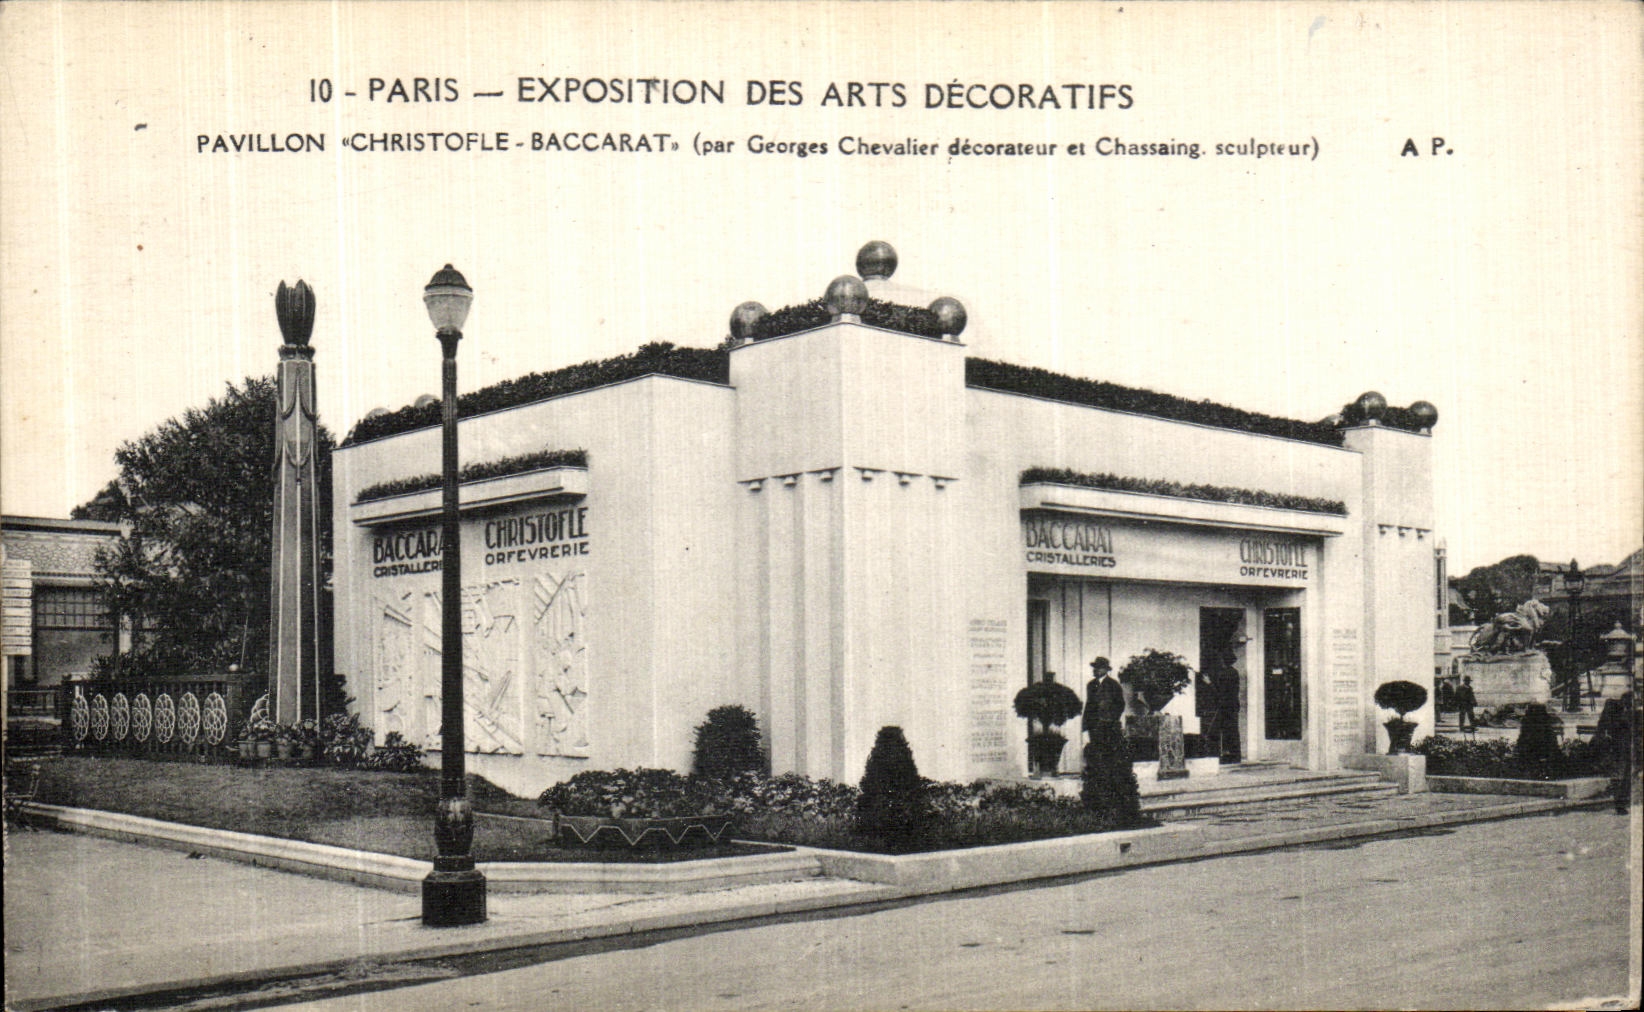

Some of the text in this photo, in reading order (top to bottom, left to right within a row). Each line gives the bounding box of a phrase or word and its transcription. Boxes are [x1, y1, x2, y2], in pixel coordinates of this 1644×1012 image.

[485, 506, 589, 549] CHRISTOFLE
[1026, 519, 1113, 553] BACCARAT
[373, 528, 444, 564] BACCARA
[485, 541, 590, 566] ORFEVRERIE
[1026, 551, 1117, 568] CRISTALLERIES
[1239, 536, 1308, 568] CHRISTOFLE
[373, 559, 444, 578] CRISTALLERI
[1239, 565, 1309, 581] ORFEVRERIE
